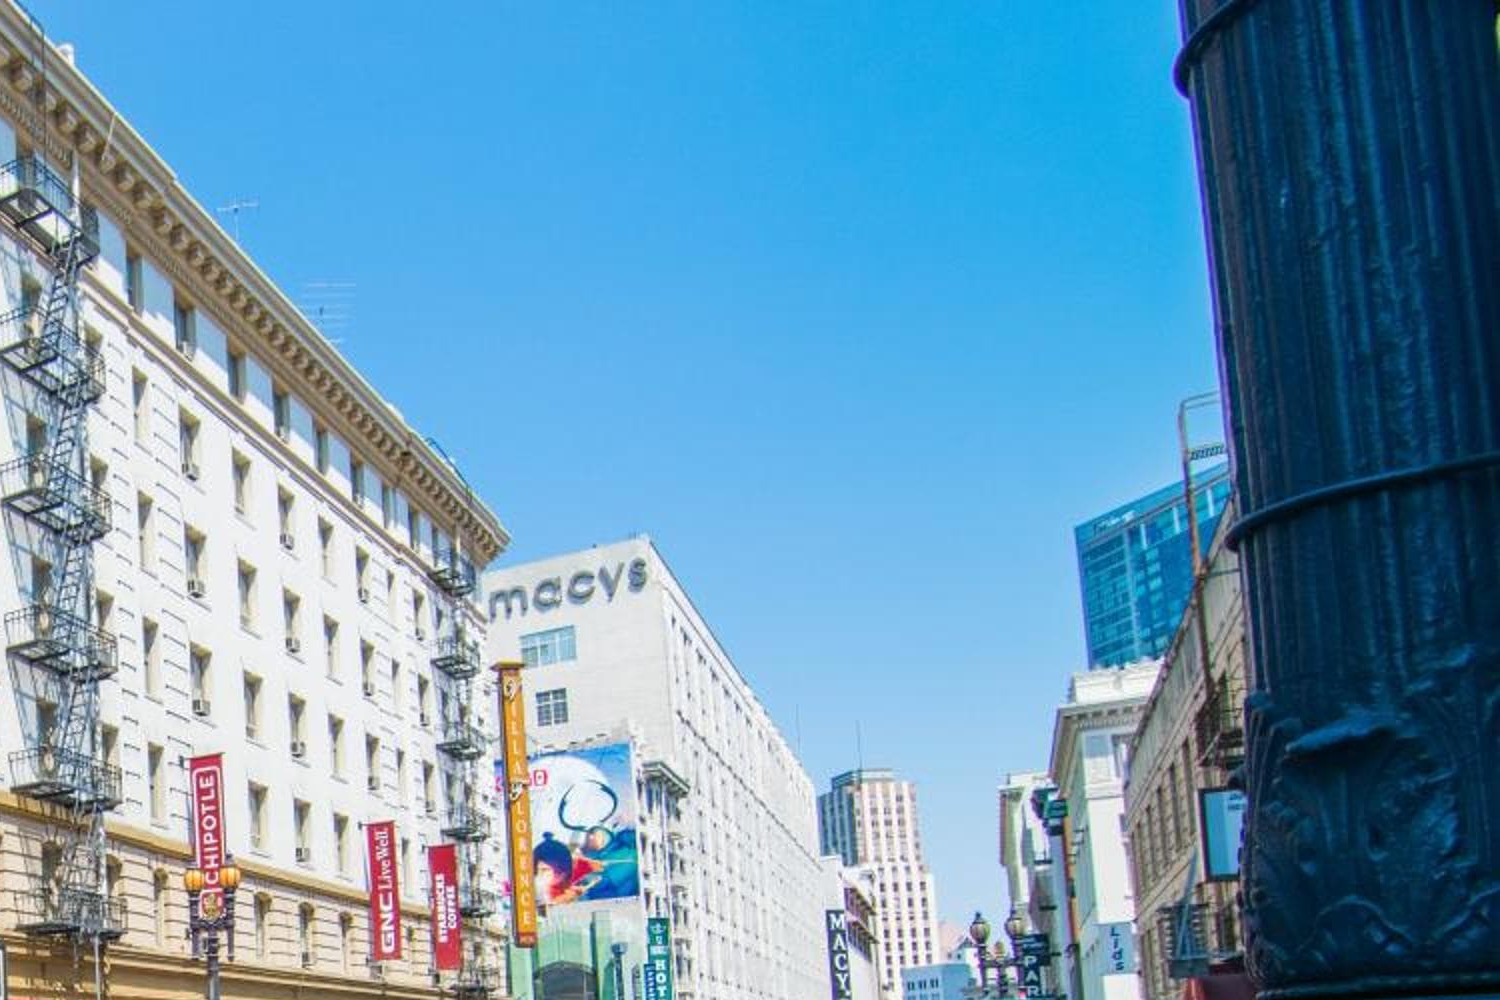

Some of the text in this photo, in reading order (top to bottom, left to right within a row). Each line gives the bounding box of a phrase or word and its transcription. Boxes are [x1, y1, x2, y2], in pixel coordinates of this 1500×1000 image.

[199, 773, 220, 886] CHIPOTLE
[379, 891, 396, 954] GNC
[1109, 927, 1125, 971] Lids
